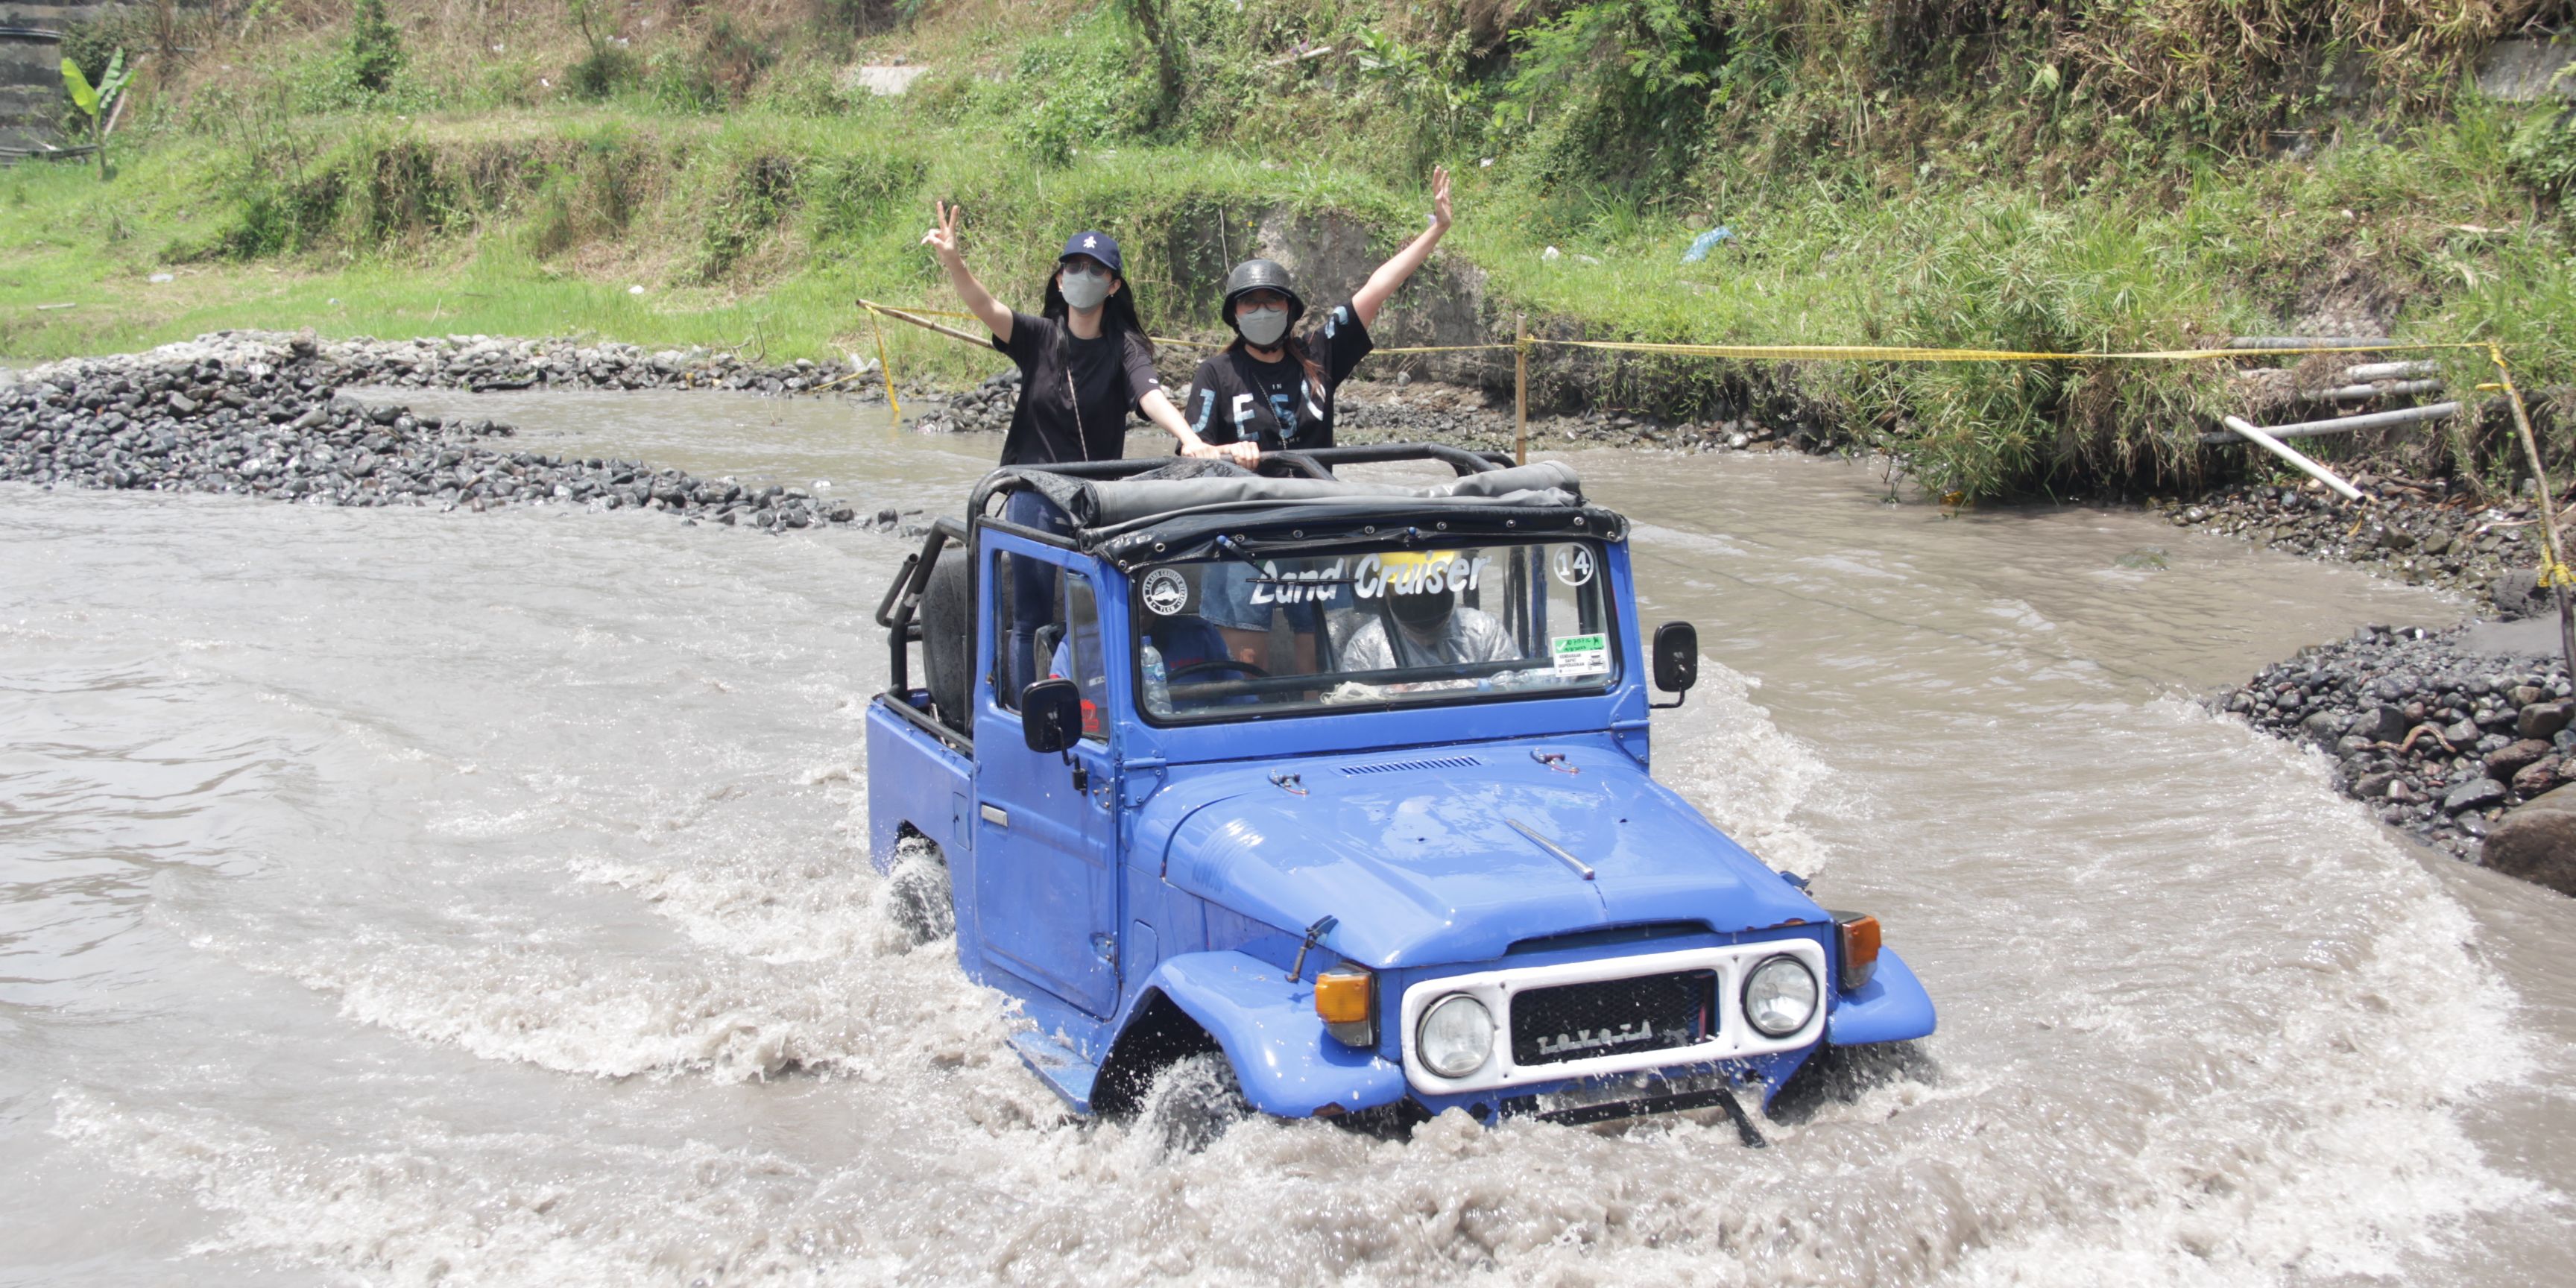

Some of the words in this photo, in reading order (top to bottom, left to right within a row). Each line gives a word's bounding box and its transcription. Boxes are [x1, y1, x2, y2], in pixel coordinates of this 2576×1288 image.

[1249, 557, 1345, 604] Land
[1354, 550, 1492, 599] Cruiser
[1559, 551, 1589, 575] 14
[1536, 1019, 1652, 1055] TOYOTA
